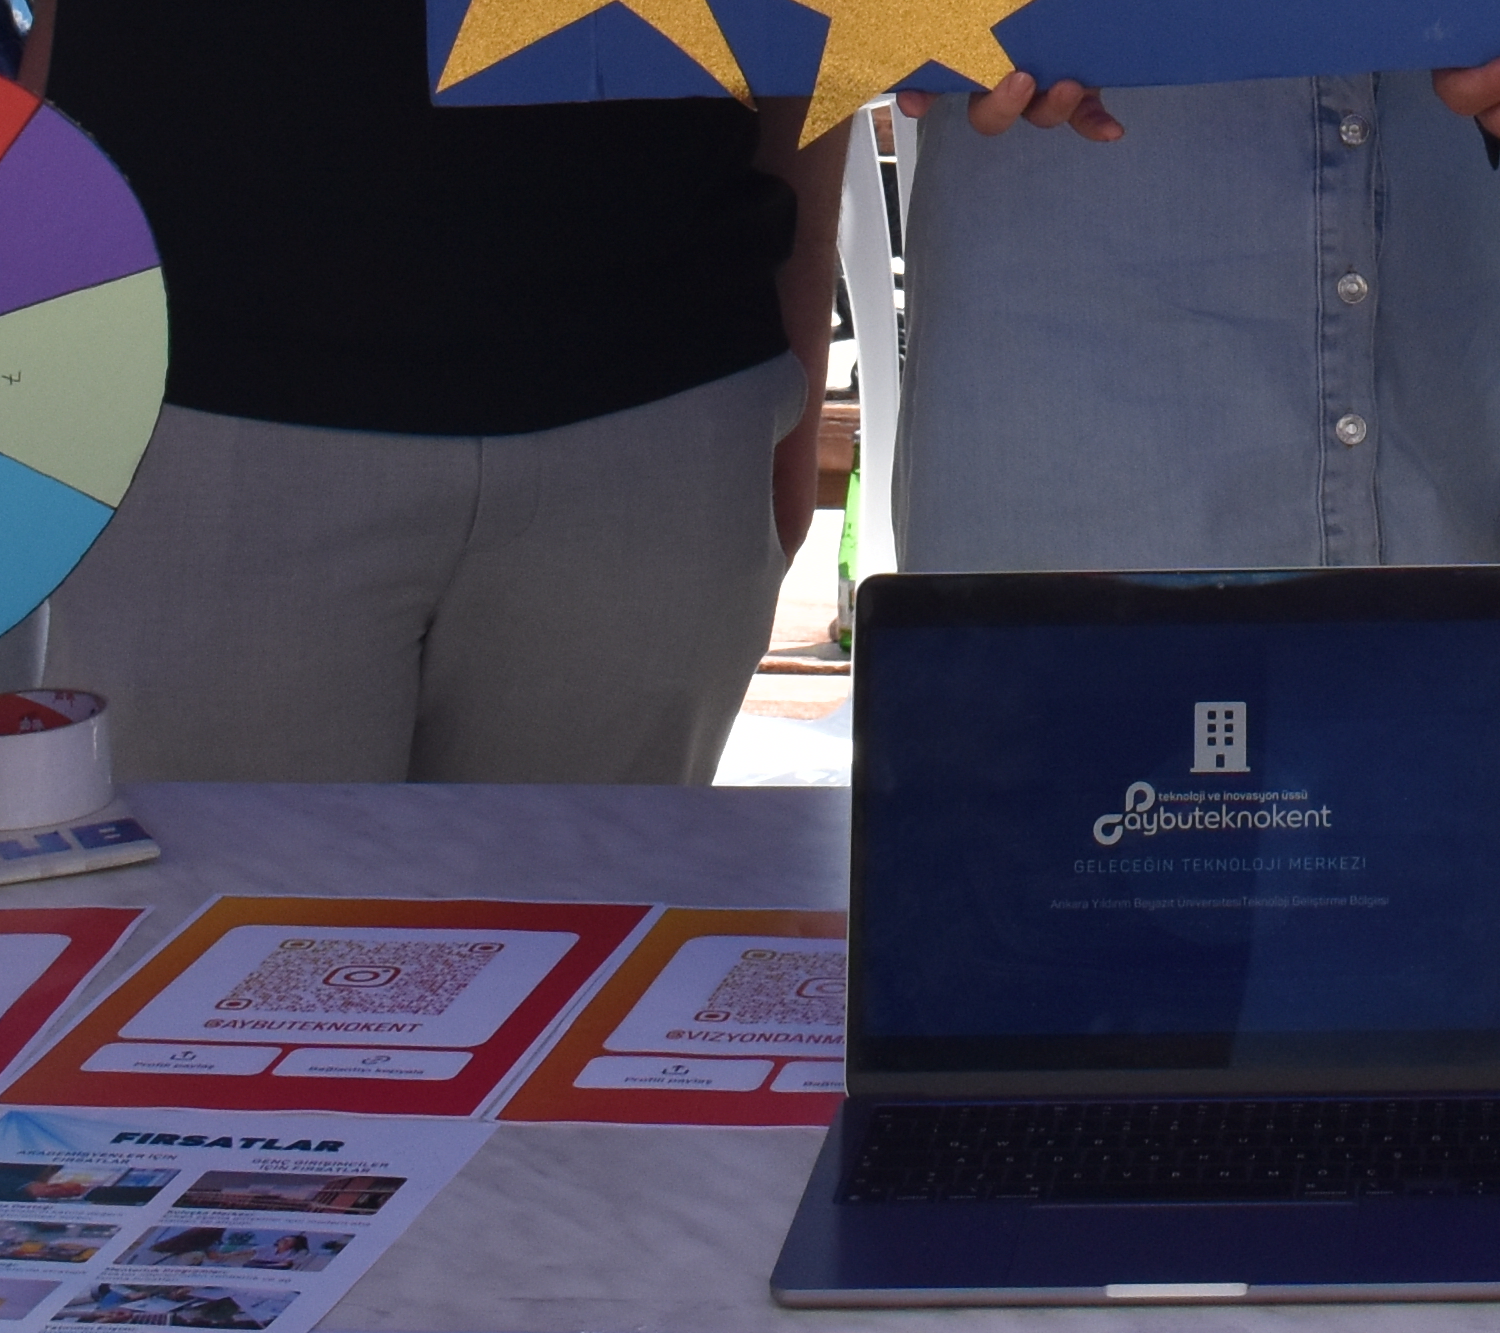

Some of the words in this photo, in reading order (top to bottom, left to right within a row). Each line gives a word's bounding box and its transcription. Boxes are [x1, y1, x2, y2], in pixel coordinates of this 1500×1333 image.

[1158, 790, 1205, 804] teknoloji
[1208, 793, 1221, 801] ve
[1223, 791, 1279, 803] inovasyon
[1124, 804, 1332, 836] aybuteknokent
[204, 1019, 423, 1033] @AYBUTEKNOKENT
[666, 1030, 846, 1044] @VIZYONDANM
[111, 1132, 345, 1152] FIRSATLAR
